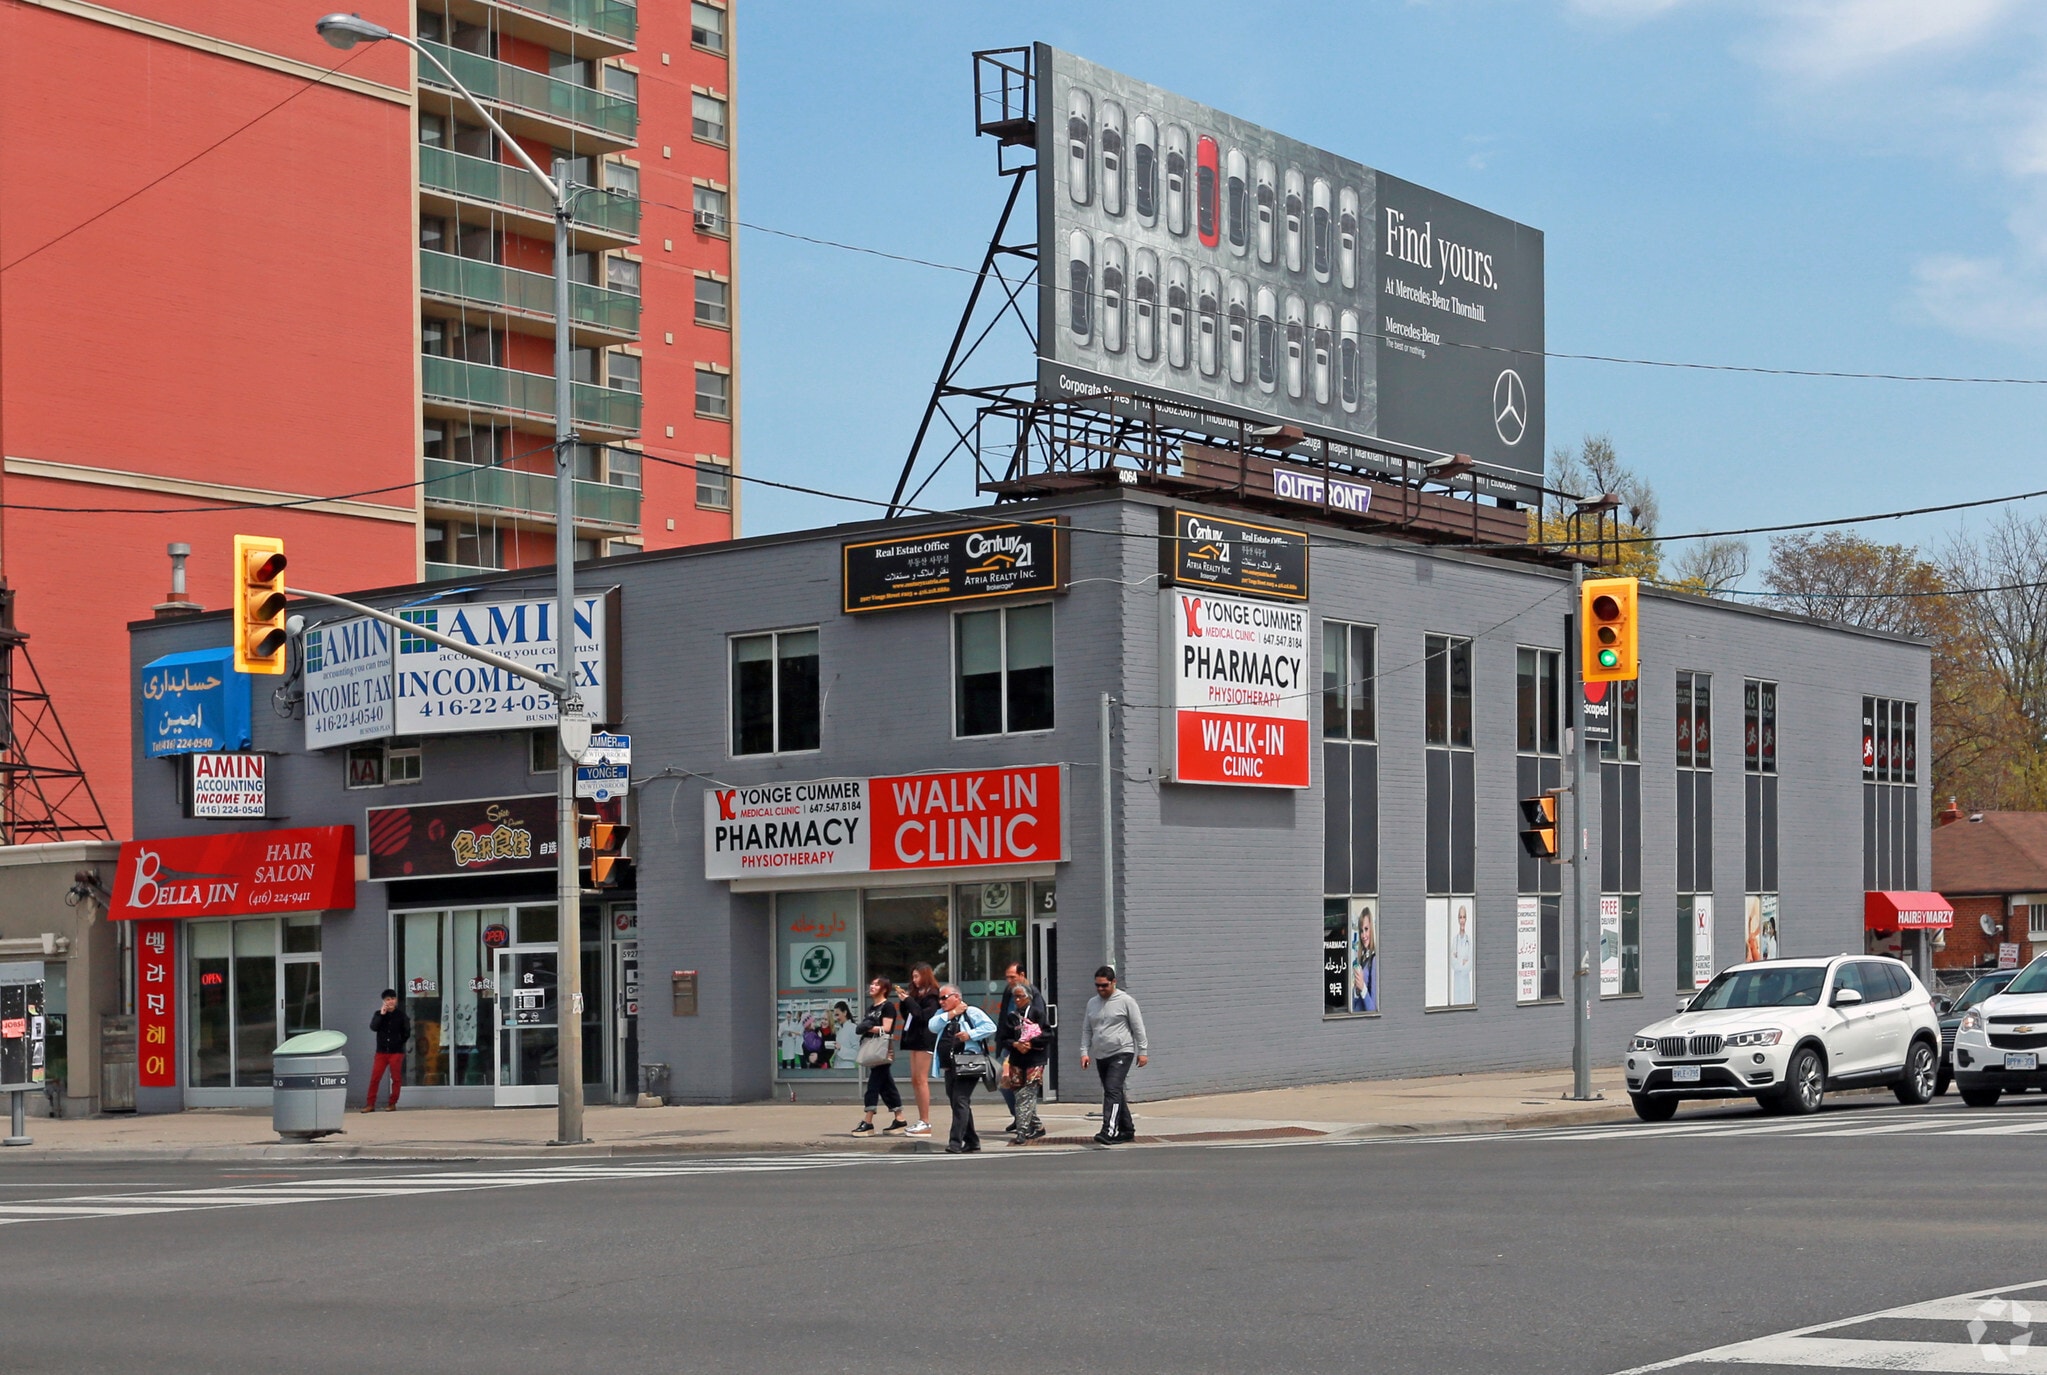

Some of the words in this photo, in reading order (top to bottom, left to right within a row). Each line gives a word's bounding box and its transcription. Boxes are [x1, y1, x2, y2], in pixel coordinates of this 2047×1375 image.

[1385, 206, 1432, 269] Find
[1438, 238, 1498, 290] yours.
[1385, 276, 1394, 295] At
[1396, 279, 1450, 312] Mercedes-Benz
[1451, 296, 1487, 323] Thornhill.
[1385, 316, 1440, 346] Mercedes-Benz
[1059, 374, 1101, 396] Corporate
[1241, 531, 1253, 542] Real
[875, 546, 894, 558] Real
[896, 545, 922, 556] Estate
[924, 541, 950, 552] Office
[966, 533, 1020, 559] Century
[1015, 542, 1032, 567] 21
[1219, 542, 1230, 563] 21
[1186, 559, 1202, 570] ATRIA
[1203, 561, 1221, 573] REALTY
[964, 576, 988, 586] ATRIA
[990, 571, 1017, 583] REALTY
[1019, 569, 1037, 579] INC.
[440, 599, 598, 649] AMIN
[1204, 601, 1250, 625] YONGE
[1252, 608, 1303, 633] CUMMER
[323, 618, 388, 668] AMIN
[1205, 627, 1234, 640] MEDICAL
[1235, 630, 1255, 642] CLINIC
[1263, 636, 1302, 649] 647.547.8184
[512, 649, 538, 660] you
[542, 647, 557, 655] ca
[574, 643, 599, 653] rust
[354, 663, 365, 674] you
[366, 661, 376, 671] can
[1184, 645, 1301, 689] PHARMACY
[398, 666, 525, 698] INCOME
[306, 681, 360, 717] INCOME
[364, 674, 392, 703] TAX
[1209, 685, 1281, 708] PHYSIOTHERAPY
[1746, 690, 1756, 709] 45
[1762, 693, 1774, 710] TO
[159, 703, 203, 735] امین
[315, 705, 384, 733] 416-224-0540
[177, 737, 213, 749] 224-0540
[590, 736, 618, 748] UMMER
[1201, 719, 1285, 756] WALK-IN
[196, 755, 263, 778] AMIN
[586, 766, 618, 779] YONGE
[1222, 755, 1263, 778] CLINIC
[196, 780, 263, 792] ACCOUNTING
[740, 786, 792, 806] YONGE
[795, 782, 861, 802] CUMMER
[892, 772, 1038, 816] WALK-IN
[196, 793, 240, 804] INCOME
[243, 793, 263, 804] TAX
[196, 805, 221, 815] (416)
[222, 805, 264, 815] 224-0540
[740, 806, 774, 819] MEDICAL
[775, 805, 800, 817] CLINIC
[809, 801, 862, 814] 647.547.8184
[715, 817, 860, 852] PHARMACY
[894, 813, 1038, 864] CLINIC
[265, 842, 312, 862] HAIR
[741, 851, 835, 868] PHYSIOTHERAPY
[254, 863, 315, 884] SALON
[202, 883, 239, 909] JIN
[248, 890, 272, 906] (416)
[273, 892, 311, 903] 224-9411
[1601, 900, 1617, 915] FREE
[485, 930, 506, 943] OPEN
[969, 919, 1018, 938] OPEN
[1323, 941, 1348, 949] PHARMACY
[201, 973, 223, 985] OPEN
[320, 1077, 336, 1086] Litter
